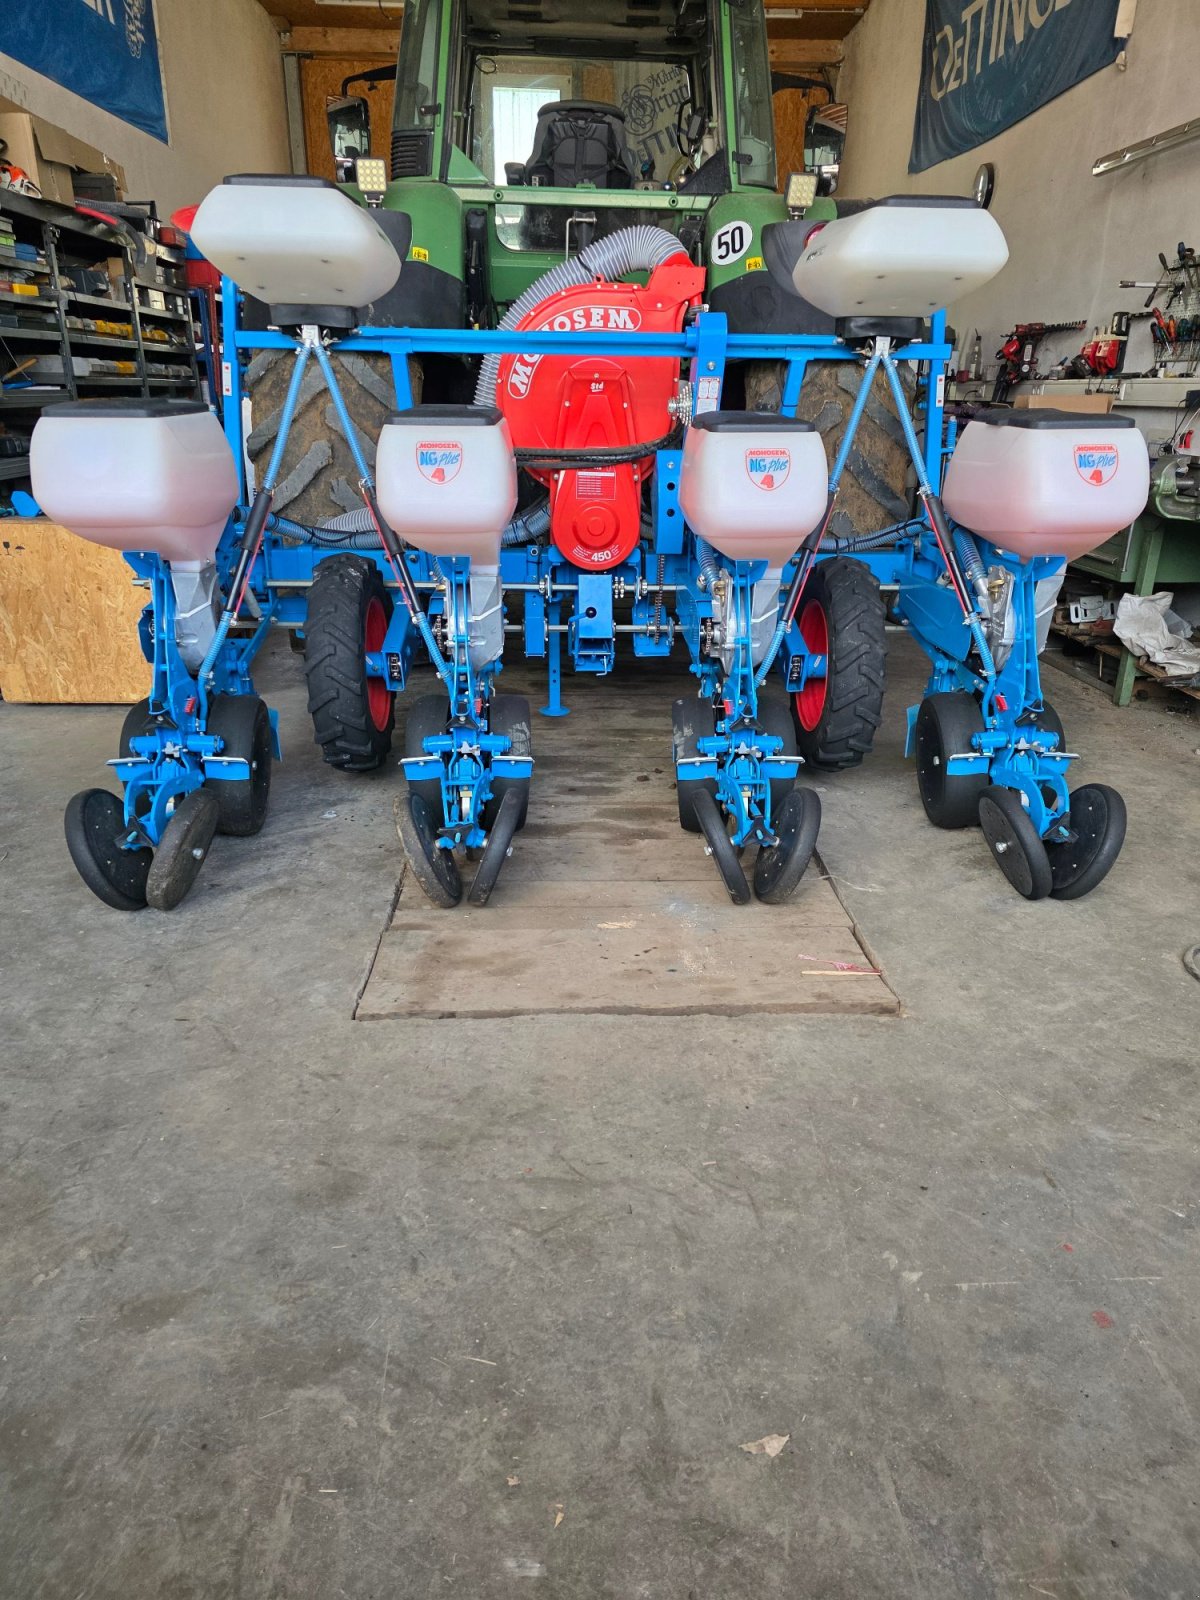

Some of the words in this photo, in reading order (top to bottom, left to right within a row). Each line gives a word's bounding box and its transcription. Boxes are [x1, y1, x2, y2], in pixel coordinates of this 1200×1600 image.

[718, 226, 744, 259] 50
[590, 382, 604, 391] Std
[420, 452, 437, 466] NG
[749, 458, 766, 473] NG
[1078, 454, 1095, 468] NG
[431, 468, 445, 482] 4
[760, 474, 774, 488] 4
[1089, 469, 1103, 484] 4
[591, 550, 612, 562] 450
